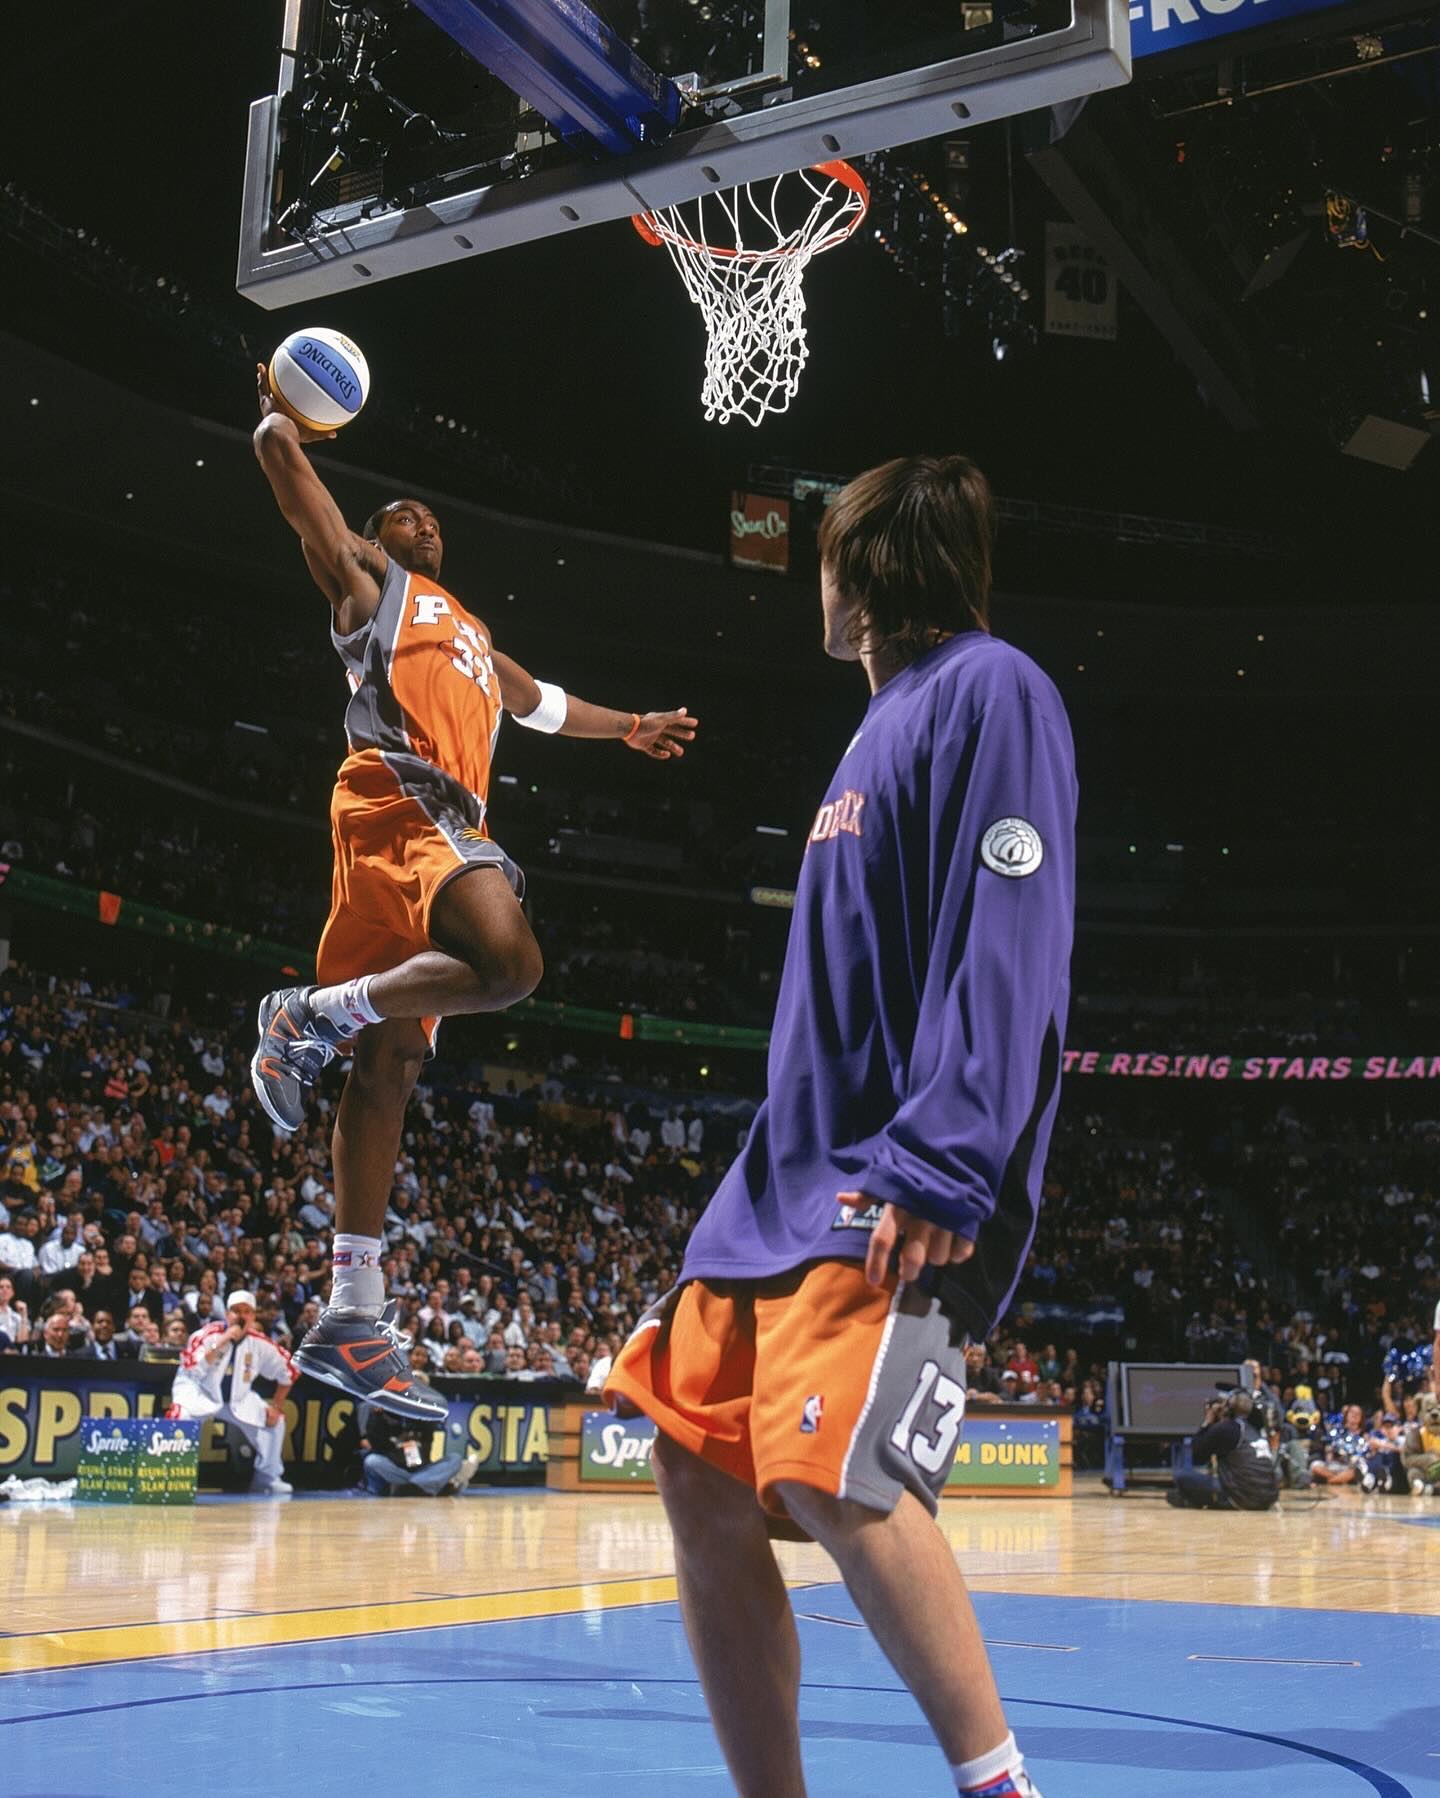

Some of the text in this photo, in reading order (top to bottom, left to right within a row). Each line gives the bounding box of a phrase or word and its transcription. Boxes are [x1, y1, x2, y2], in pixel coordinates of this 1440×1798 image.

[1055, 266, 1107, 305] 40
[298, 342, 357, 400] SPALDING
[1109, 1053, 1232, 1081] RISING
[1242, 1056, 1352, 1080] STARS
[891, 1360, 966, 1472] 13
[86, 1429, 129, 1455] Sprite
[147, 1431, 192, 1457] Sprite
[980, 1444, 1048, 1466] DUNK
